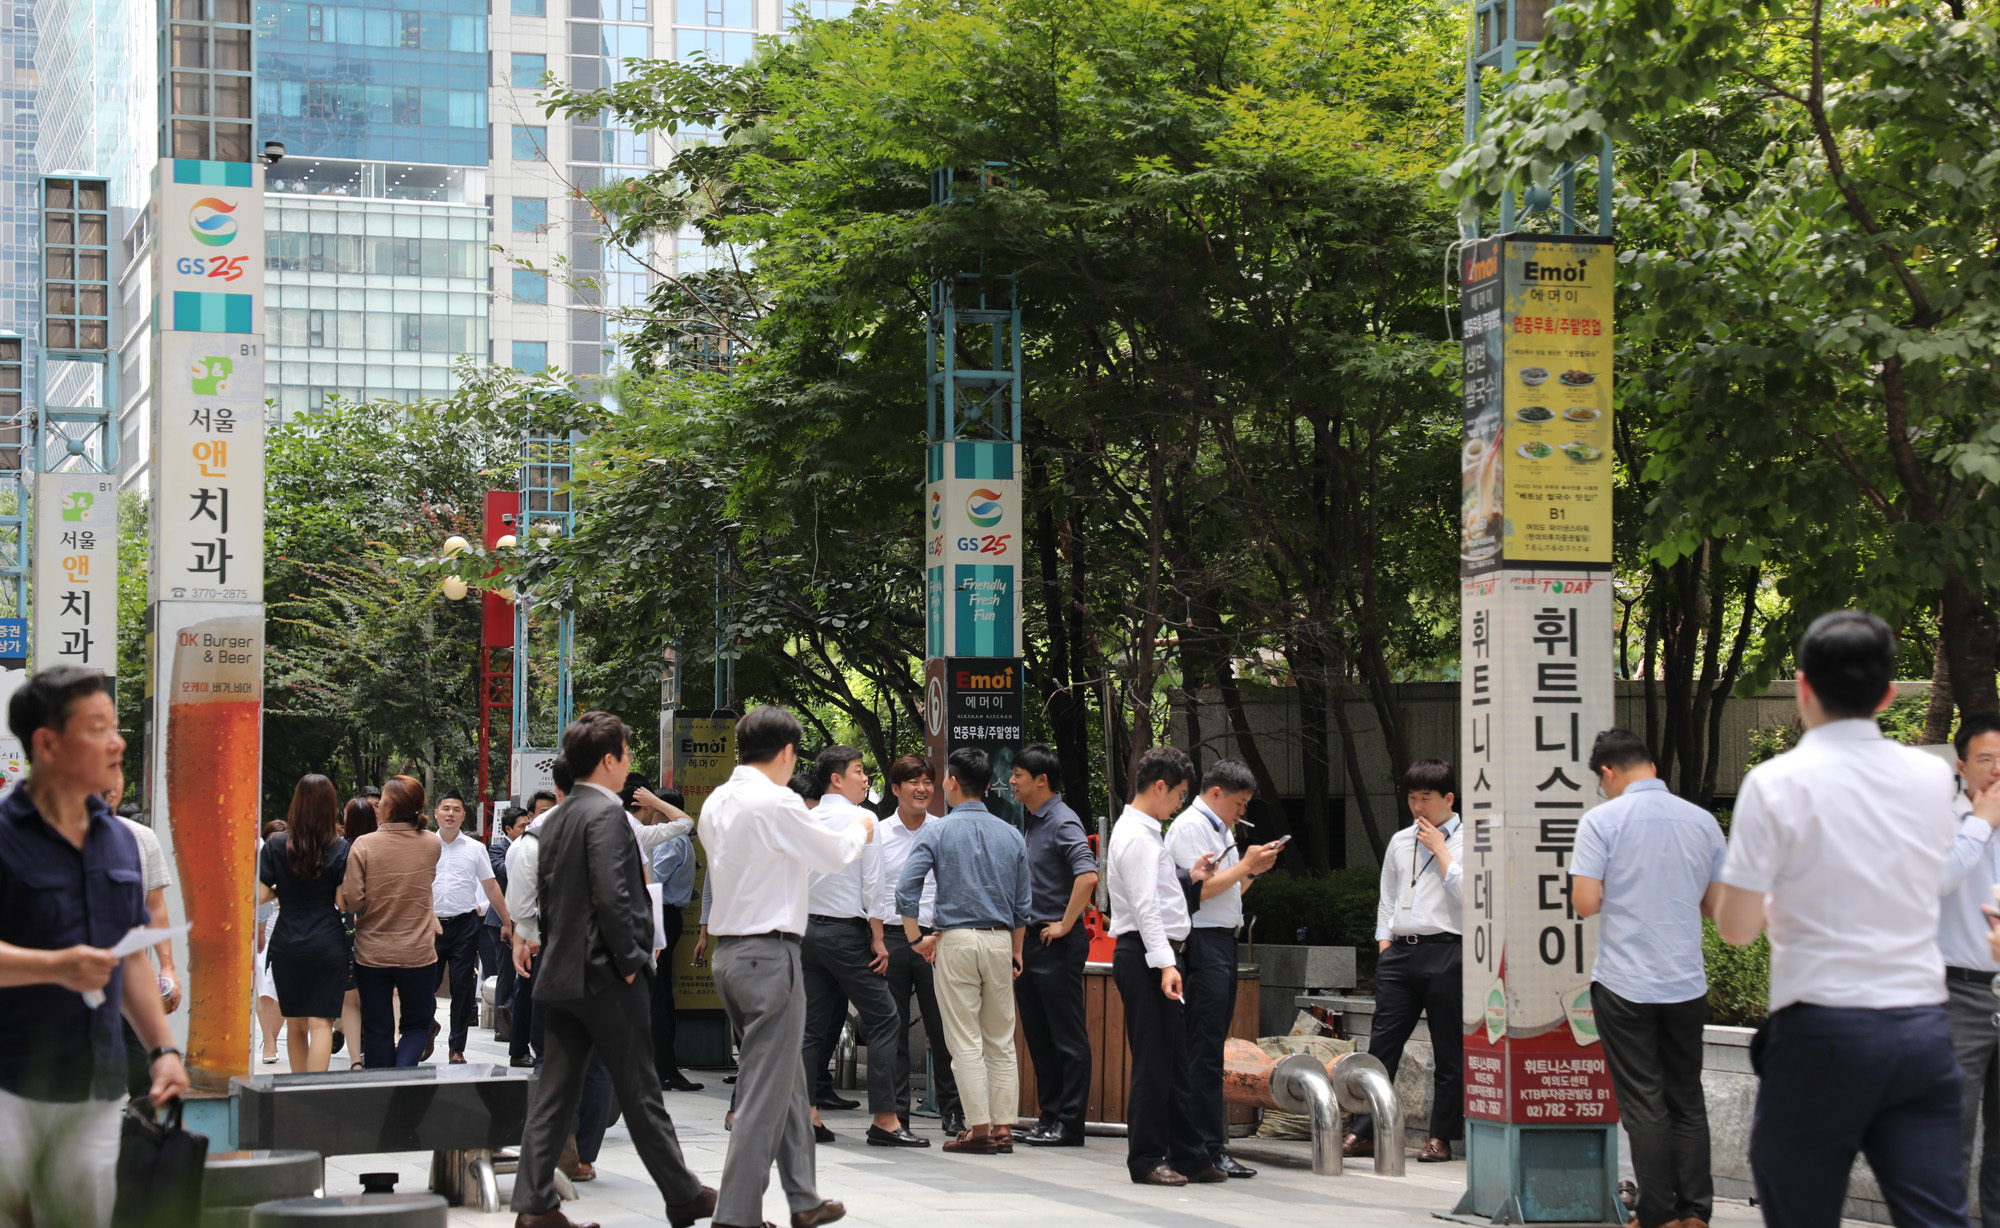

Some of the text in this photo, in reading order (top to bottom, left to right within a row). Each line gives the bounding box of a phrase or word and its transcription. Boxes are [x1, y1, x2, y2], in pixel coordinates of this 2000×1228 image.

[176, 255, 249, 282] GS25
[1531, 289, 1578, 304] 에머이
[1513, 316, 1602, 337] 연중무휴/주말영업
[240, 344, 256, 356] B1
[1464, 342, 1486, 374] 생면
[189, 408, 237, 433] 서울
[192, 440, 228, 477] 앤
[99, 482, 113, 492] B1
[1547, 493, 1571, 501] 쌀국수
[1549, 508, 1566, 520] B1
[60, 531, 96, 549] 서울
[186, 487, 234, 585] 치과
[957, 534, 1012, 556] GS25
[62, 555, 89, 583] 앤
[191, 588, 248, 599] 3770-2875
[962, 577, 1007, 595] Friendly
[968, 593, 1001, 606] Fresh
[973, 608, 996, 622] Fun
[58, 590, 94, 664] 치과
[180, 633, 253, 648] OK Burger
[203, 650, 253, 664] & Beer
[182, 682, 209, 693] 오케이
[965, 696, 1003, 709] 에머이
[953, 725, 1020, 740] 연중무휴/주말영업
[1472, 608, 1493, 973] 휘트니스투데이
[1533, 607, 1584, 974] 휘트니스투데이
[1524, 1059, 1605, 1075] 휘트니스투데이
[1541, 1076, 1589, 1087] 여의도센터
[1520, 1089, 1610, 1101] KTB투자증권빌딩 B1
[1526, 1105, 1543, 1118] 02)
